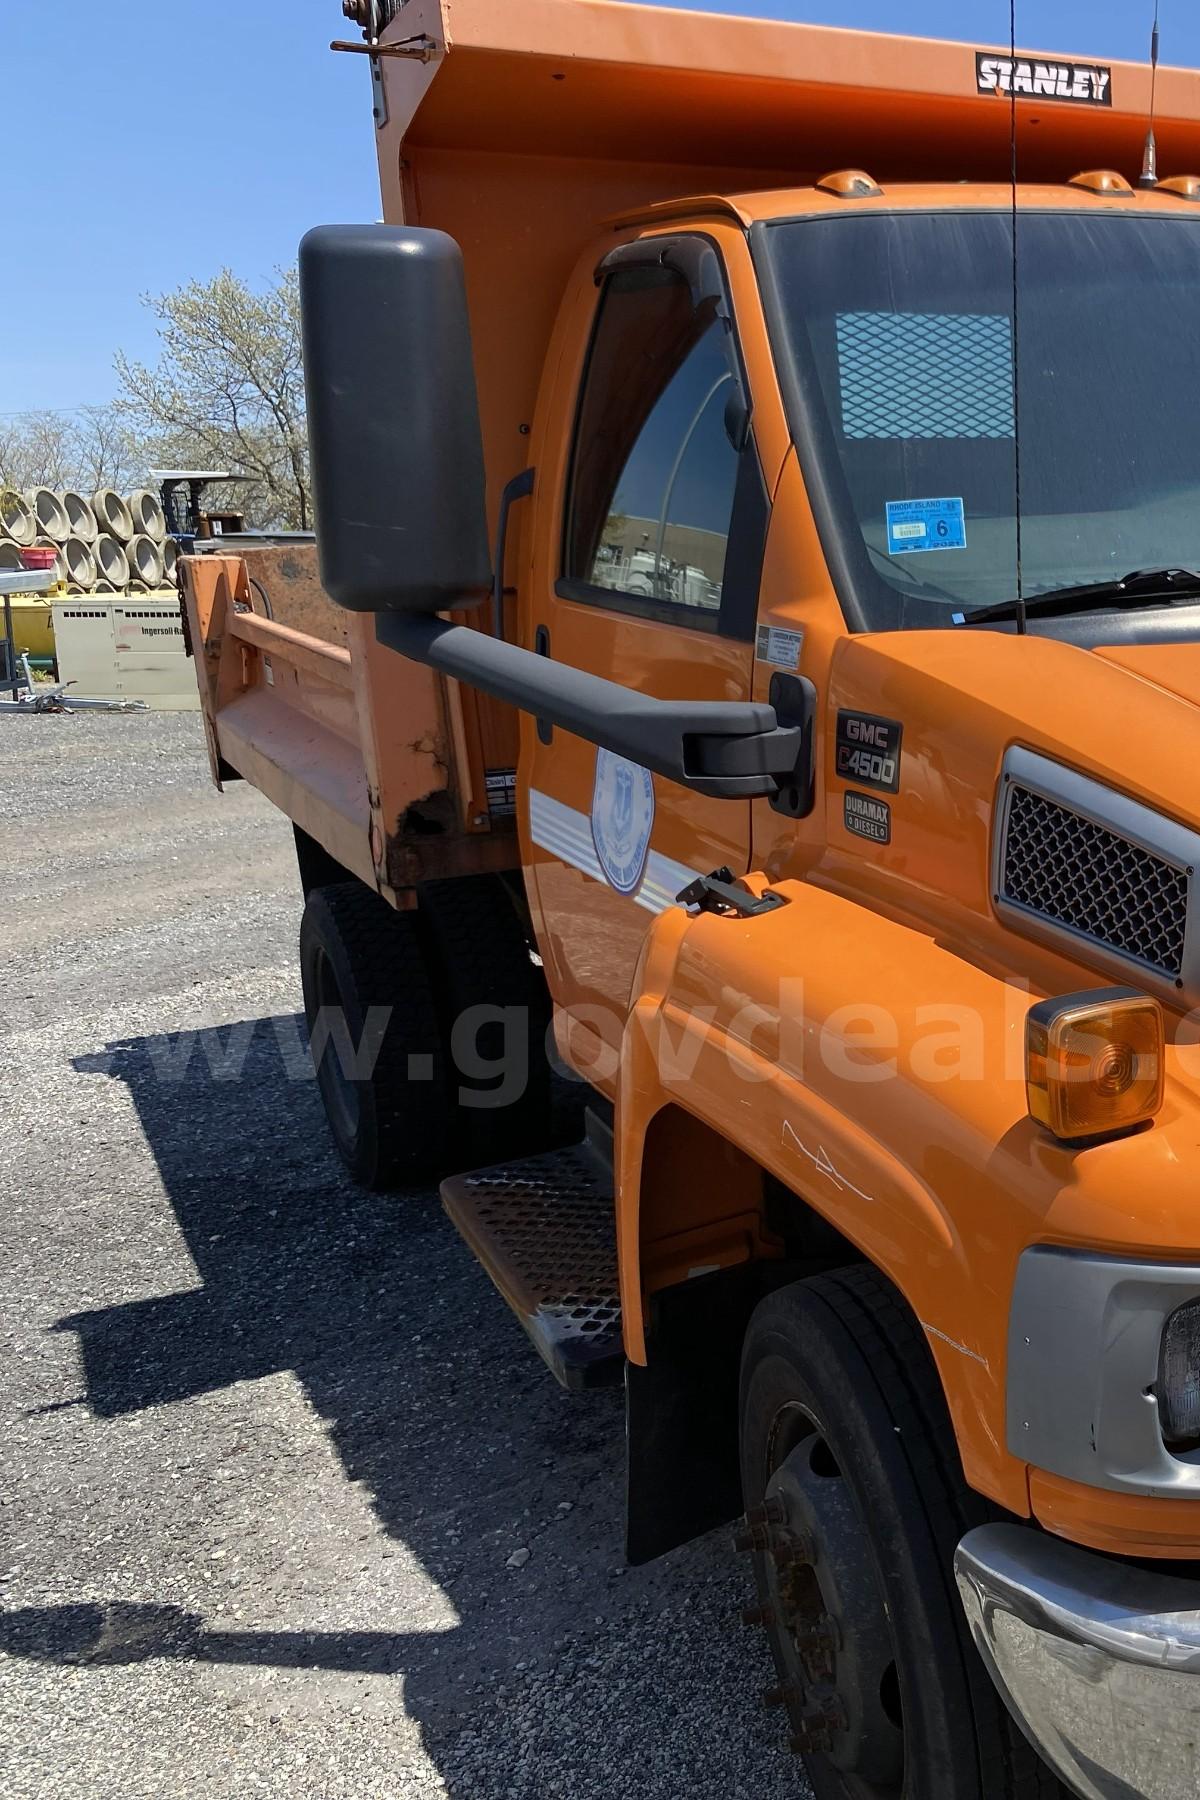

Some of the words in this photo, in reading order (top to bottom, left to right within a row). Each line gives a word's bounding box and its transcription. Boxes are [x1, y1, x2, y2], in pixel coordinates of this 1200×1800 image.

[978, 57, 1109, 101] STANLEY
[936, 519, 949, 538] 6
[846, 719, 889, 748] GMC
[838, 745, 895, 784] C4500
[845, 795, 889, 824] DURAMAX
[854, 817, 880, 837] DIESEL
